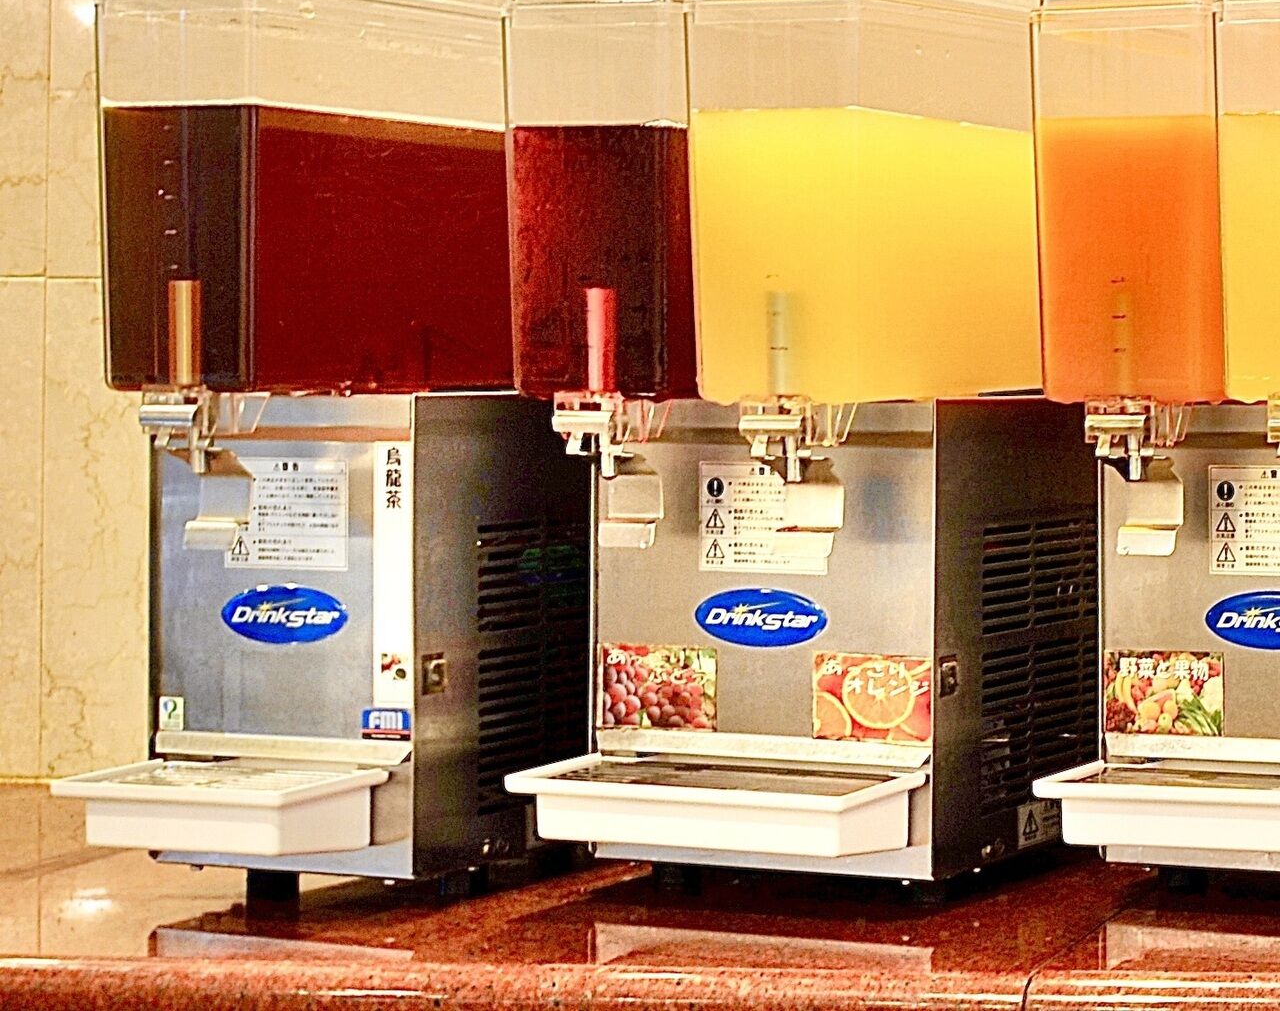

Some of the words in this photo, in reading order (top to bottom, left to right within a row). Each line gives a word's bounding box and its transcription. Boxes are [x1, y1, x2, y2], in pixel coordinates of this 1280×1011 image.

[231, 605, 341, 629] Drinkstar
[705, 607, 819, 631] Drinkstar
[1119, 657, 1210, 681] 野菜と果物
[846, 677, 930, 697] オレンジ
